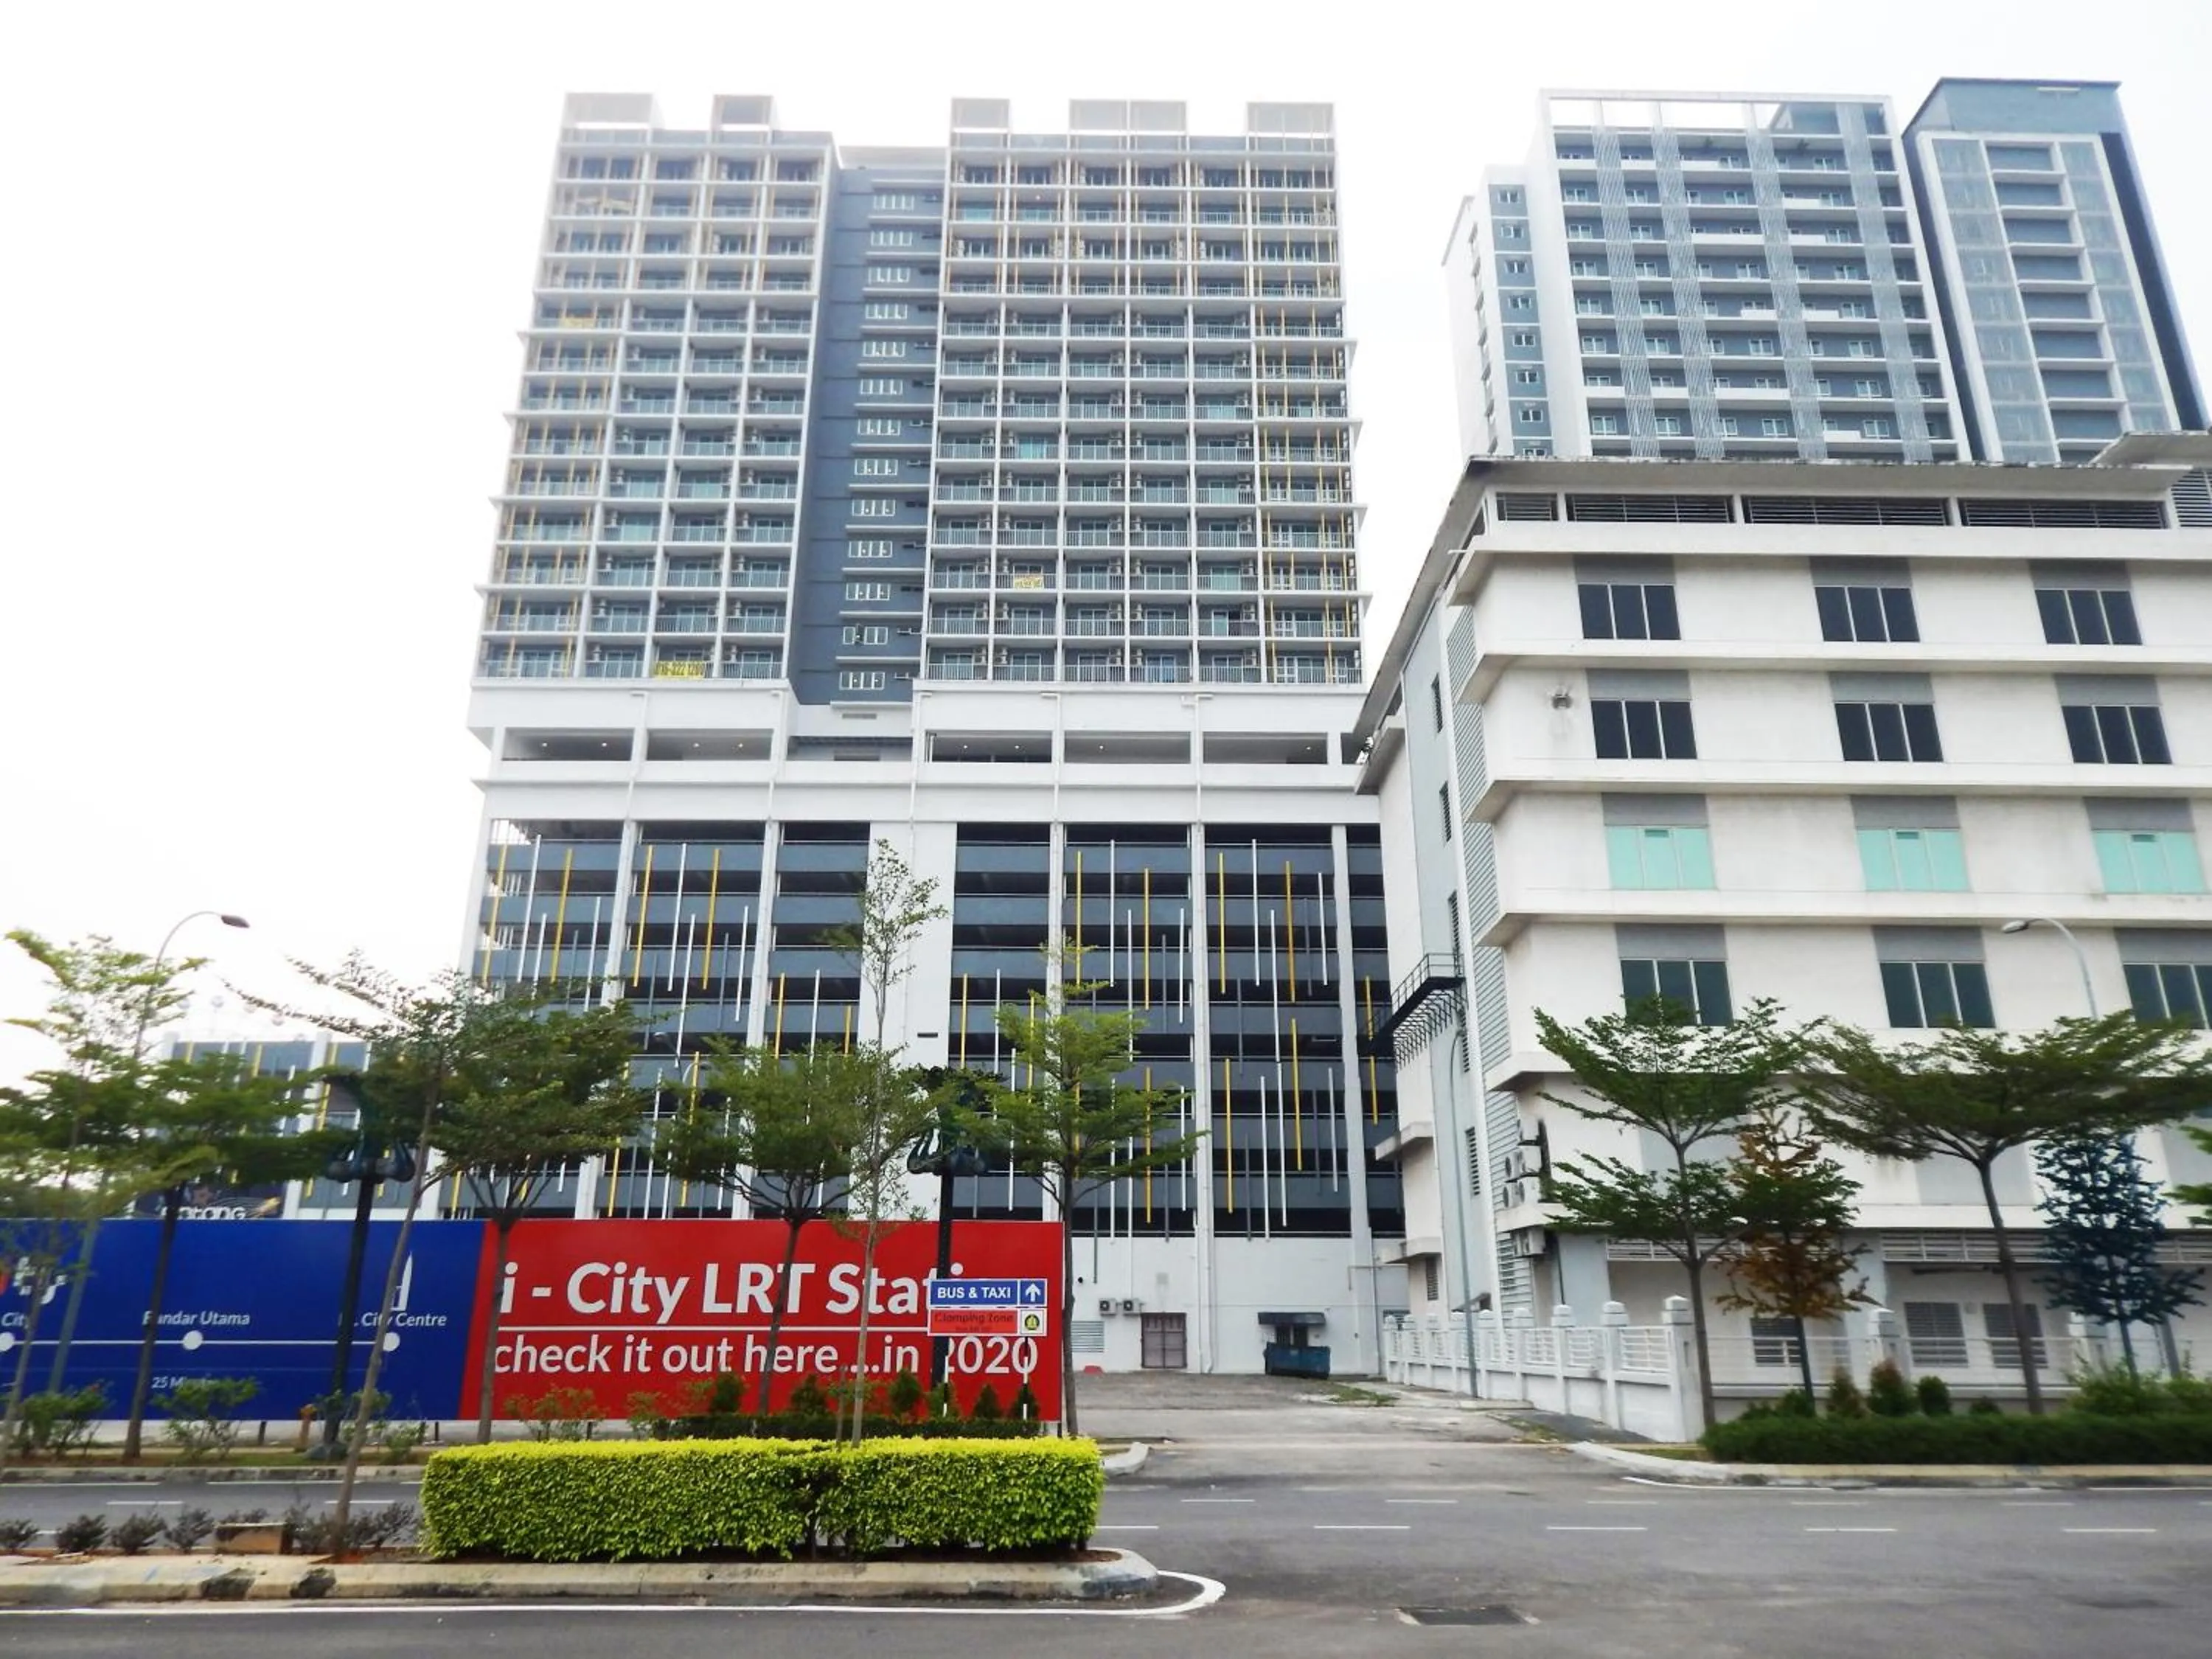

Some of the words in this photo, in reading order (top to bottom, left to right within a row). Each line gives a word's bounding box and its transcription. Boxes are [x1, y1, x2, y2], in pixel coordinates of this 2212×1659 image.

[499, 1262, 518, 1314] i
[532, 1286, 552, 1298] -
[566, 1262, 689, 1325] City
[701, 1262, 816, 1314] LRT
[936, 1287, 965, 1299] BUS
[968, 1287, 978, 1299] &
[981, 1287, 1011, 1299] TAXI
[1, 1312, 29, 1329] Cit
[142, 1310, 198, 1326] Bndar
[199, 1310, 251, 1326] Utama
[395, 1312, 448, 1327] Centre
[494, 1334, 613, 1374] check
[623, 1334, 653, 1373] it
[662, 1337, 734, 1374] out
